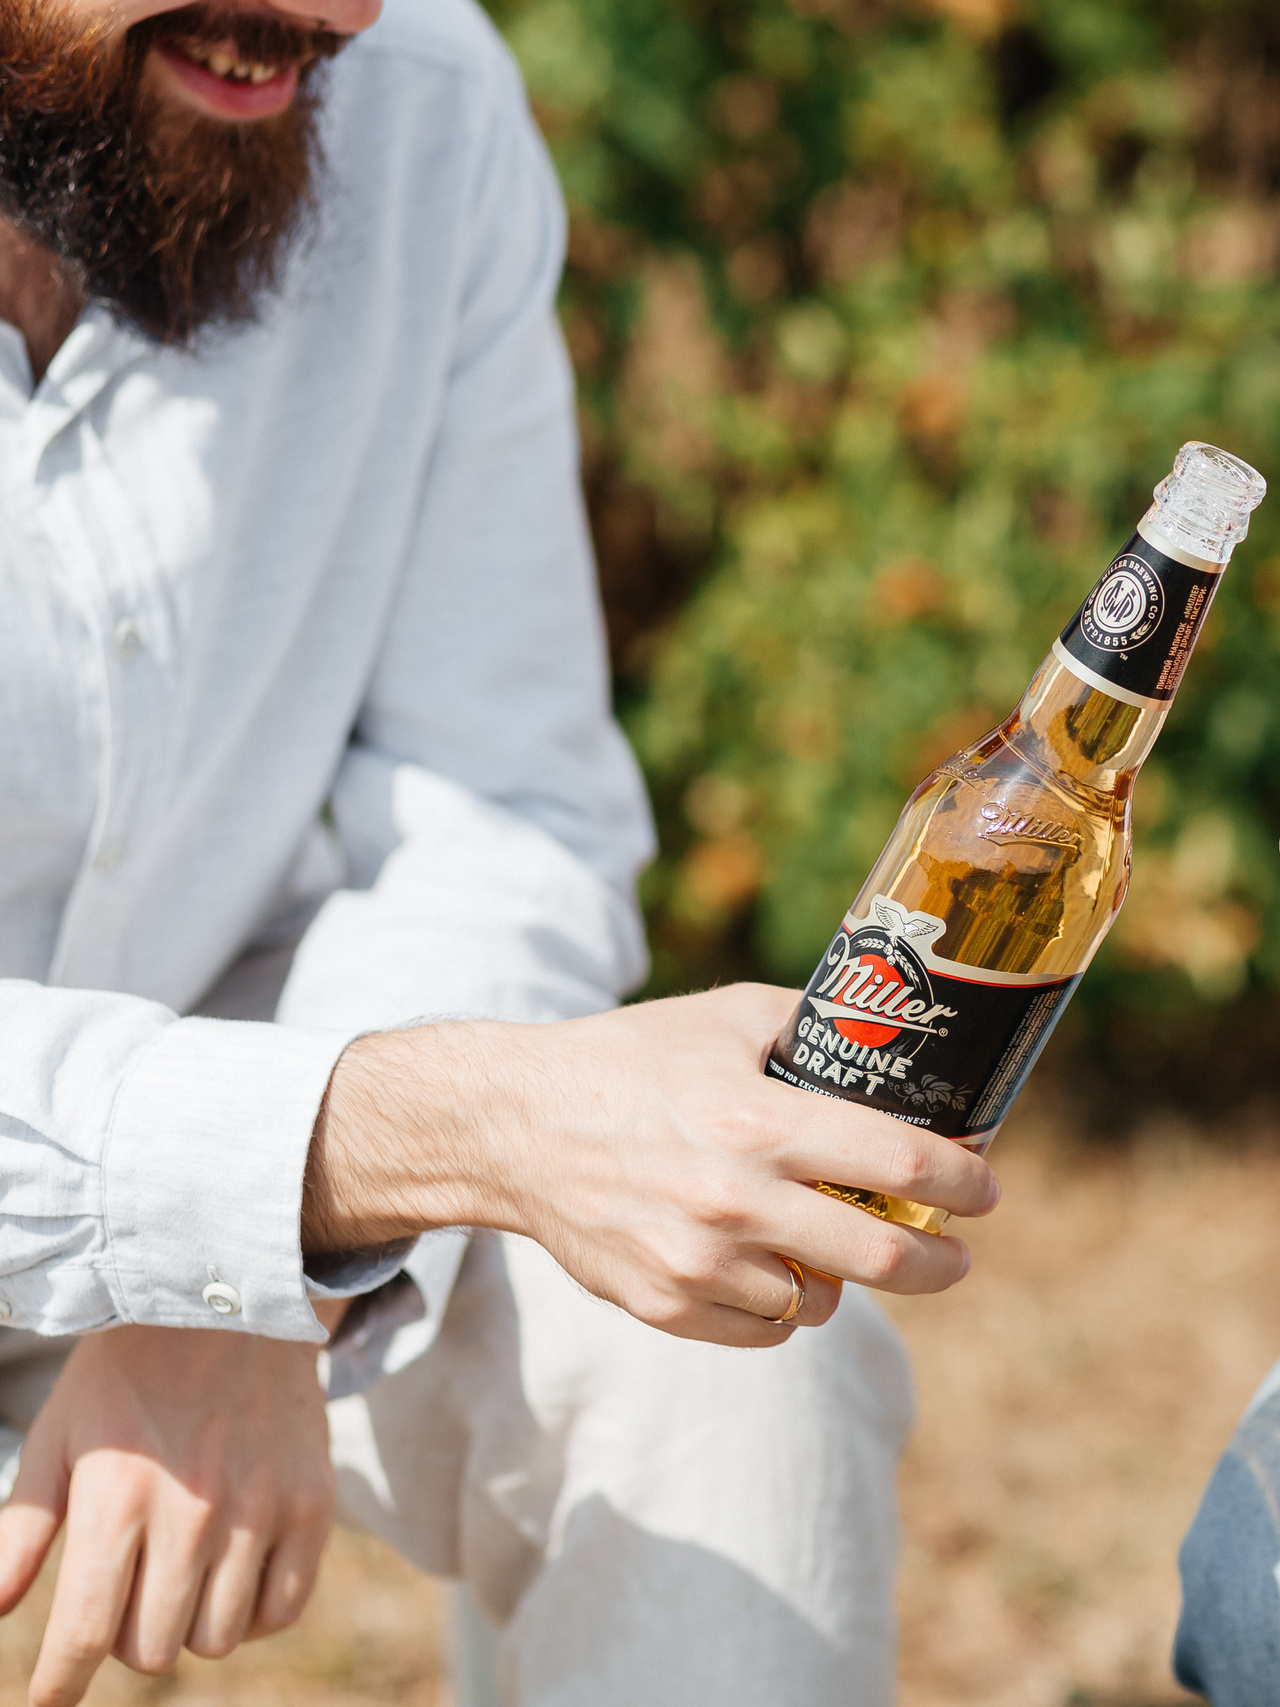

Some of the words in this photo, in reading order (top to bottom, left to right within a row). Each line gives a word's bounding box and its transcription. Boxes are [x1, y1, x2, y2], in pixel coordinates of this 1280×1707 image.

[1129, 561, 1159, 602] BREWING
[1148, 605, 1158, 619] CO
[1096, 633, 1128, 646] 1855
[1156, 659, 1173, 690] ПИВНОЙ
[1169, 622, 1187, 656] НАПИТОК
[1164, 649, 1185, 690] ДЖЕНЬЮИН
[1180, 620, 1195, 649] ДРАФТ»
[1189, 586, 1208, 620] ПАСТЕРИ-
[980, 802, 1085, 843] Miller
[816, 932, 958, 1024] Miller
[793, 1042, 885, 1096] DRAFT
[797, 1016, 913, 1080] GENUINE
[784, 1071, 799, 1084] FOR
